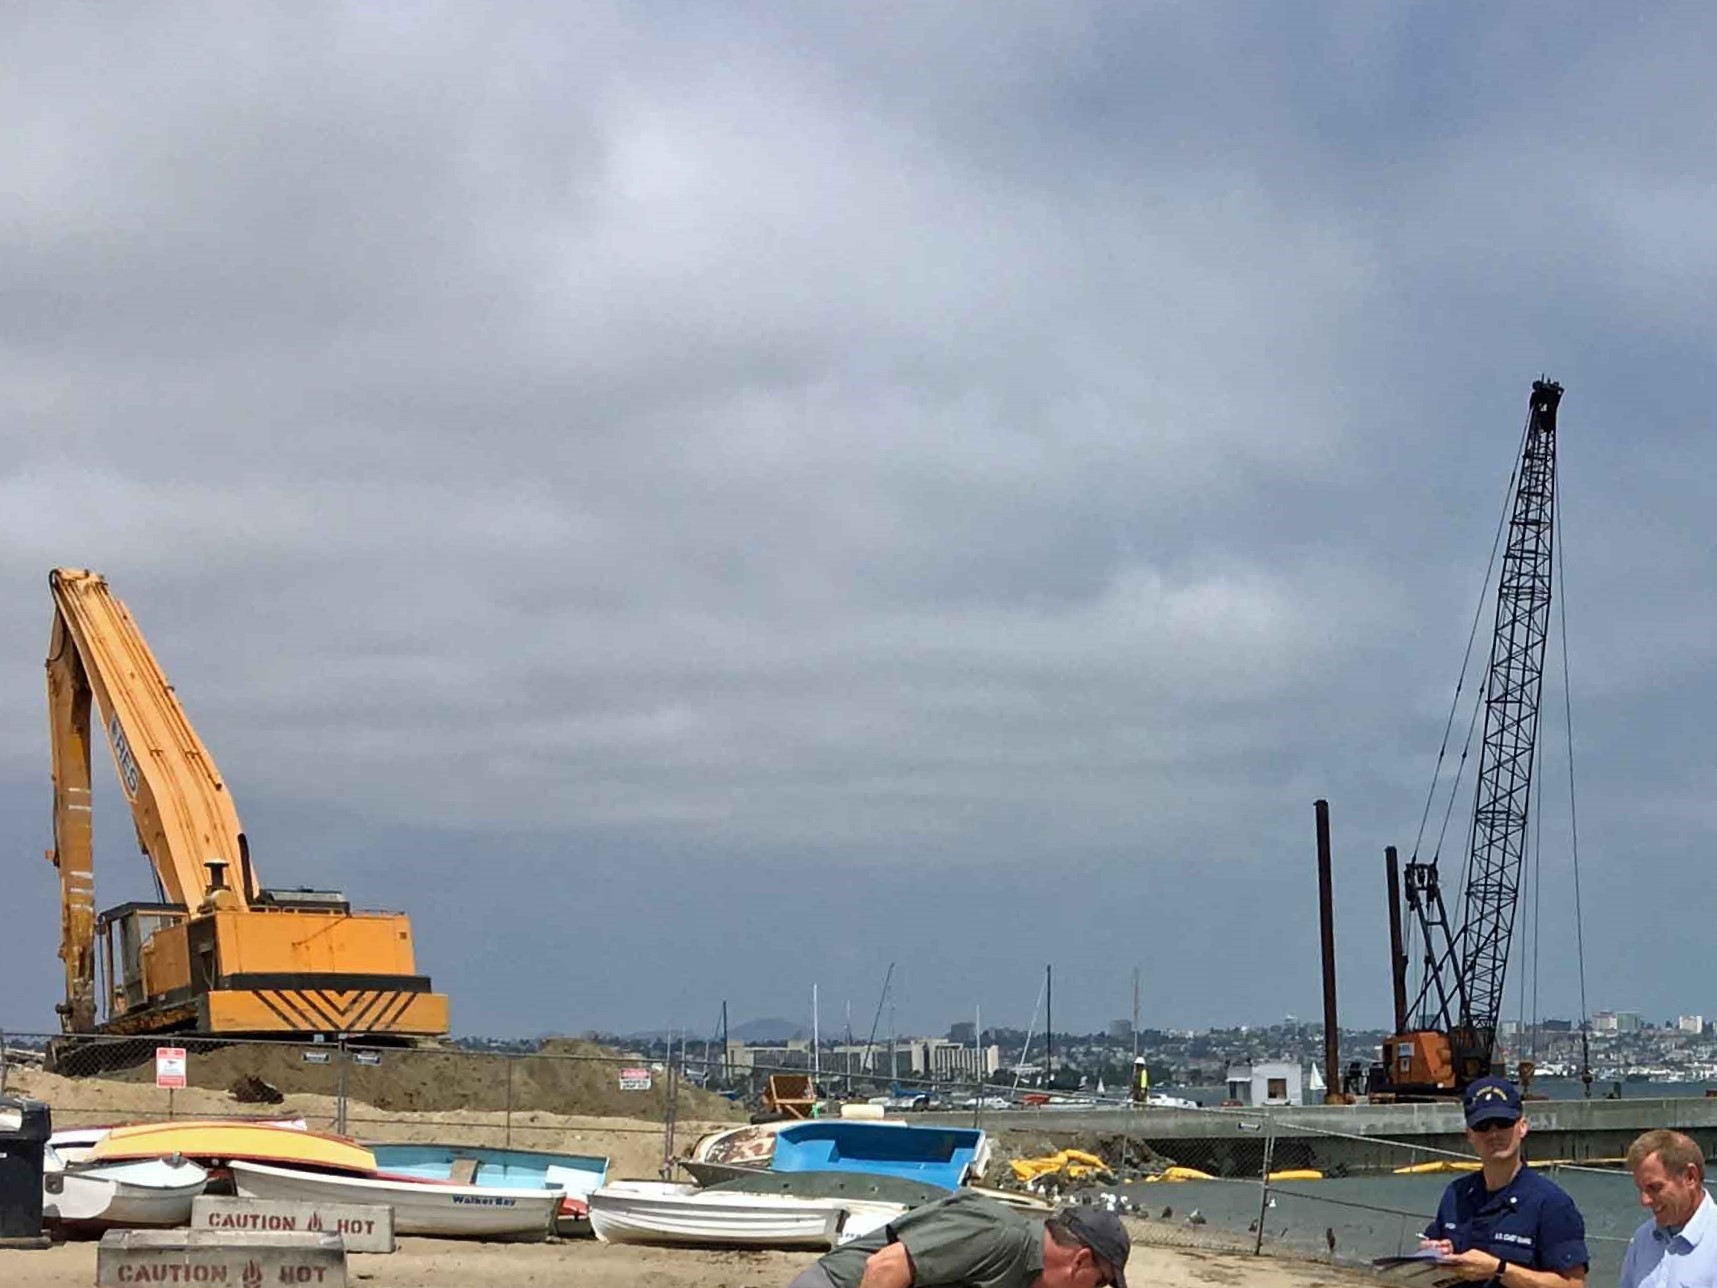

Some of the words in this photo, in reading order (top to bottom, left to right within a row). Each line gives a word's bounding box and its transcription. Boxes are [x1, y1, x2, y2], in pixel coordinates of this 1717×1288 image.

[453, 1194, 493, 1205] Walker
[495, 1197, 516, 1206] Bay
[208, 1212, 296, 1231] CAUTION
[337, 1219, 375, 1235] HOT
[117, 1263, 228, 1283] CAUTION
[279, 1265, 328, 1284] HOT
